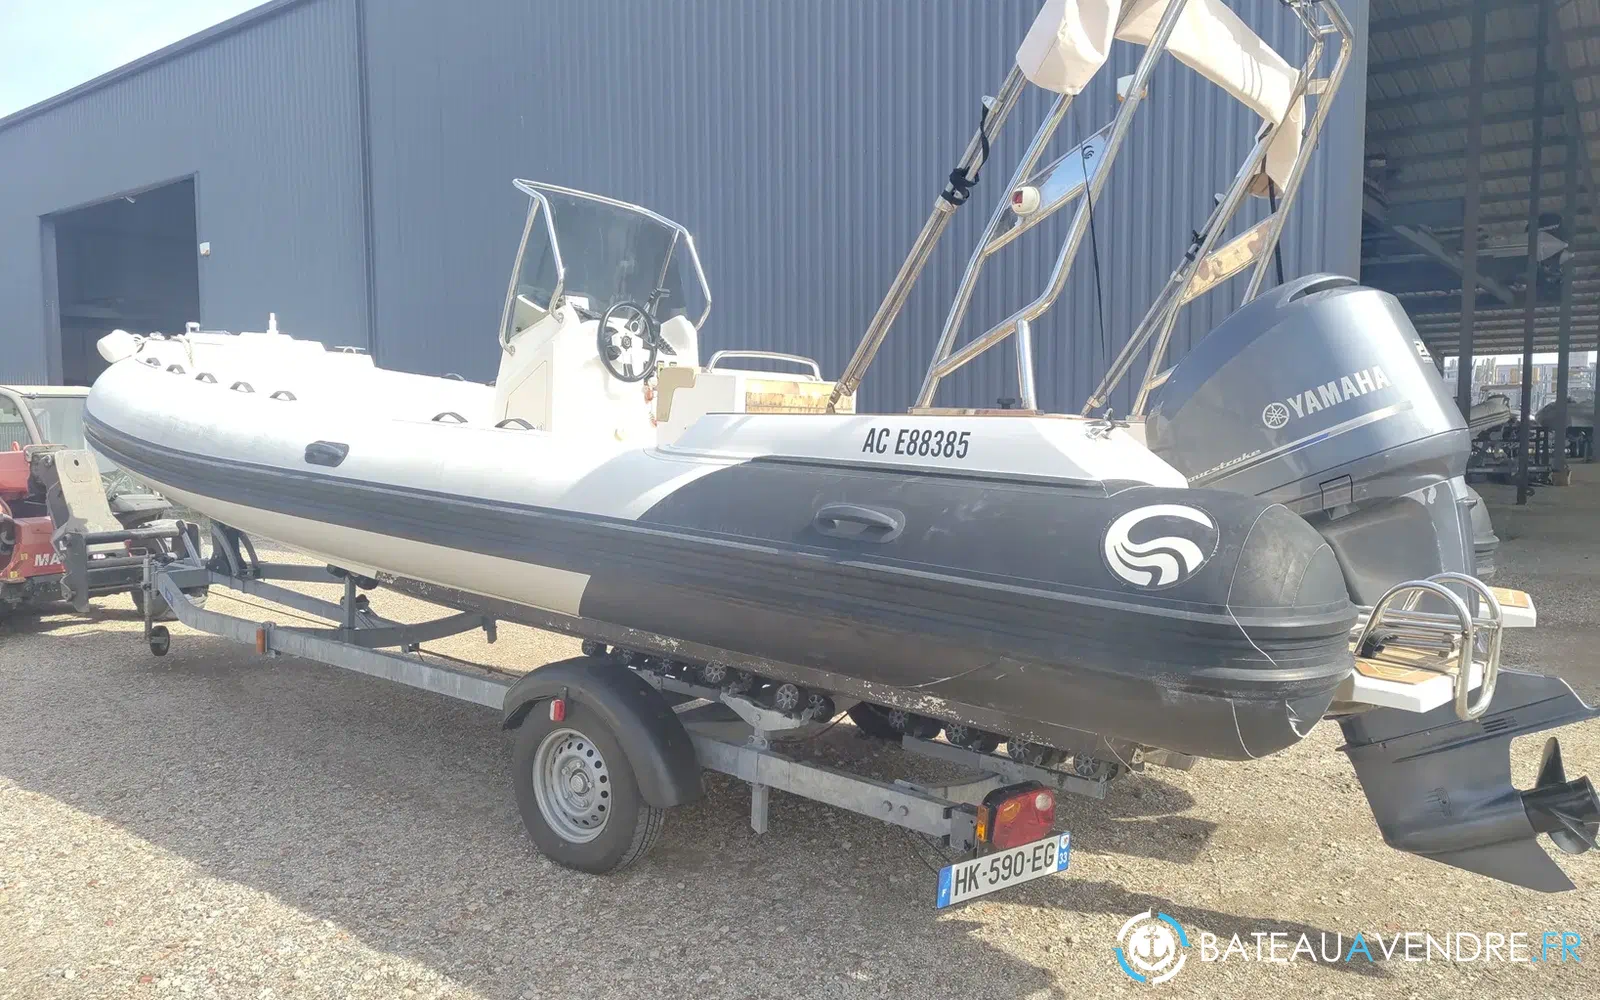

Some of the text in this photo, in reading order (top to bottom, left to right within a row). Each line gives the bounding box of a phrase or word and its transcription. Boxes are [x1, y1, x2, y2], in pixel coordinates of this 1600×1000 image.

[1286, 365, 1393, 419] YAMAHA
[861, 427, 971, 459] AC E88385
[1187, 449, 1262, 483] ourstroke
[34, 552, 61, 567] MA
[954, 842, 1056, 896] HK-590-EG
[1058, 852, 1068, 865] 33
[941, 888, 947, 898] F
